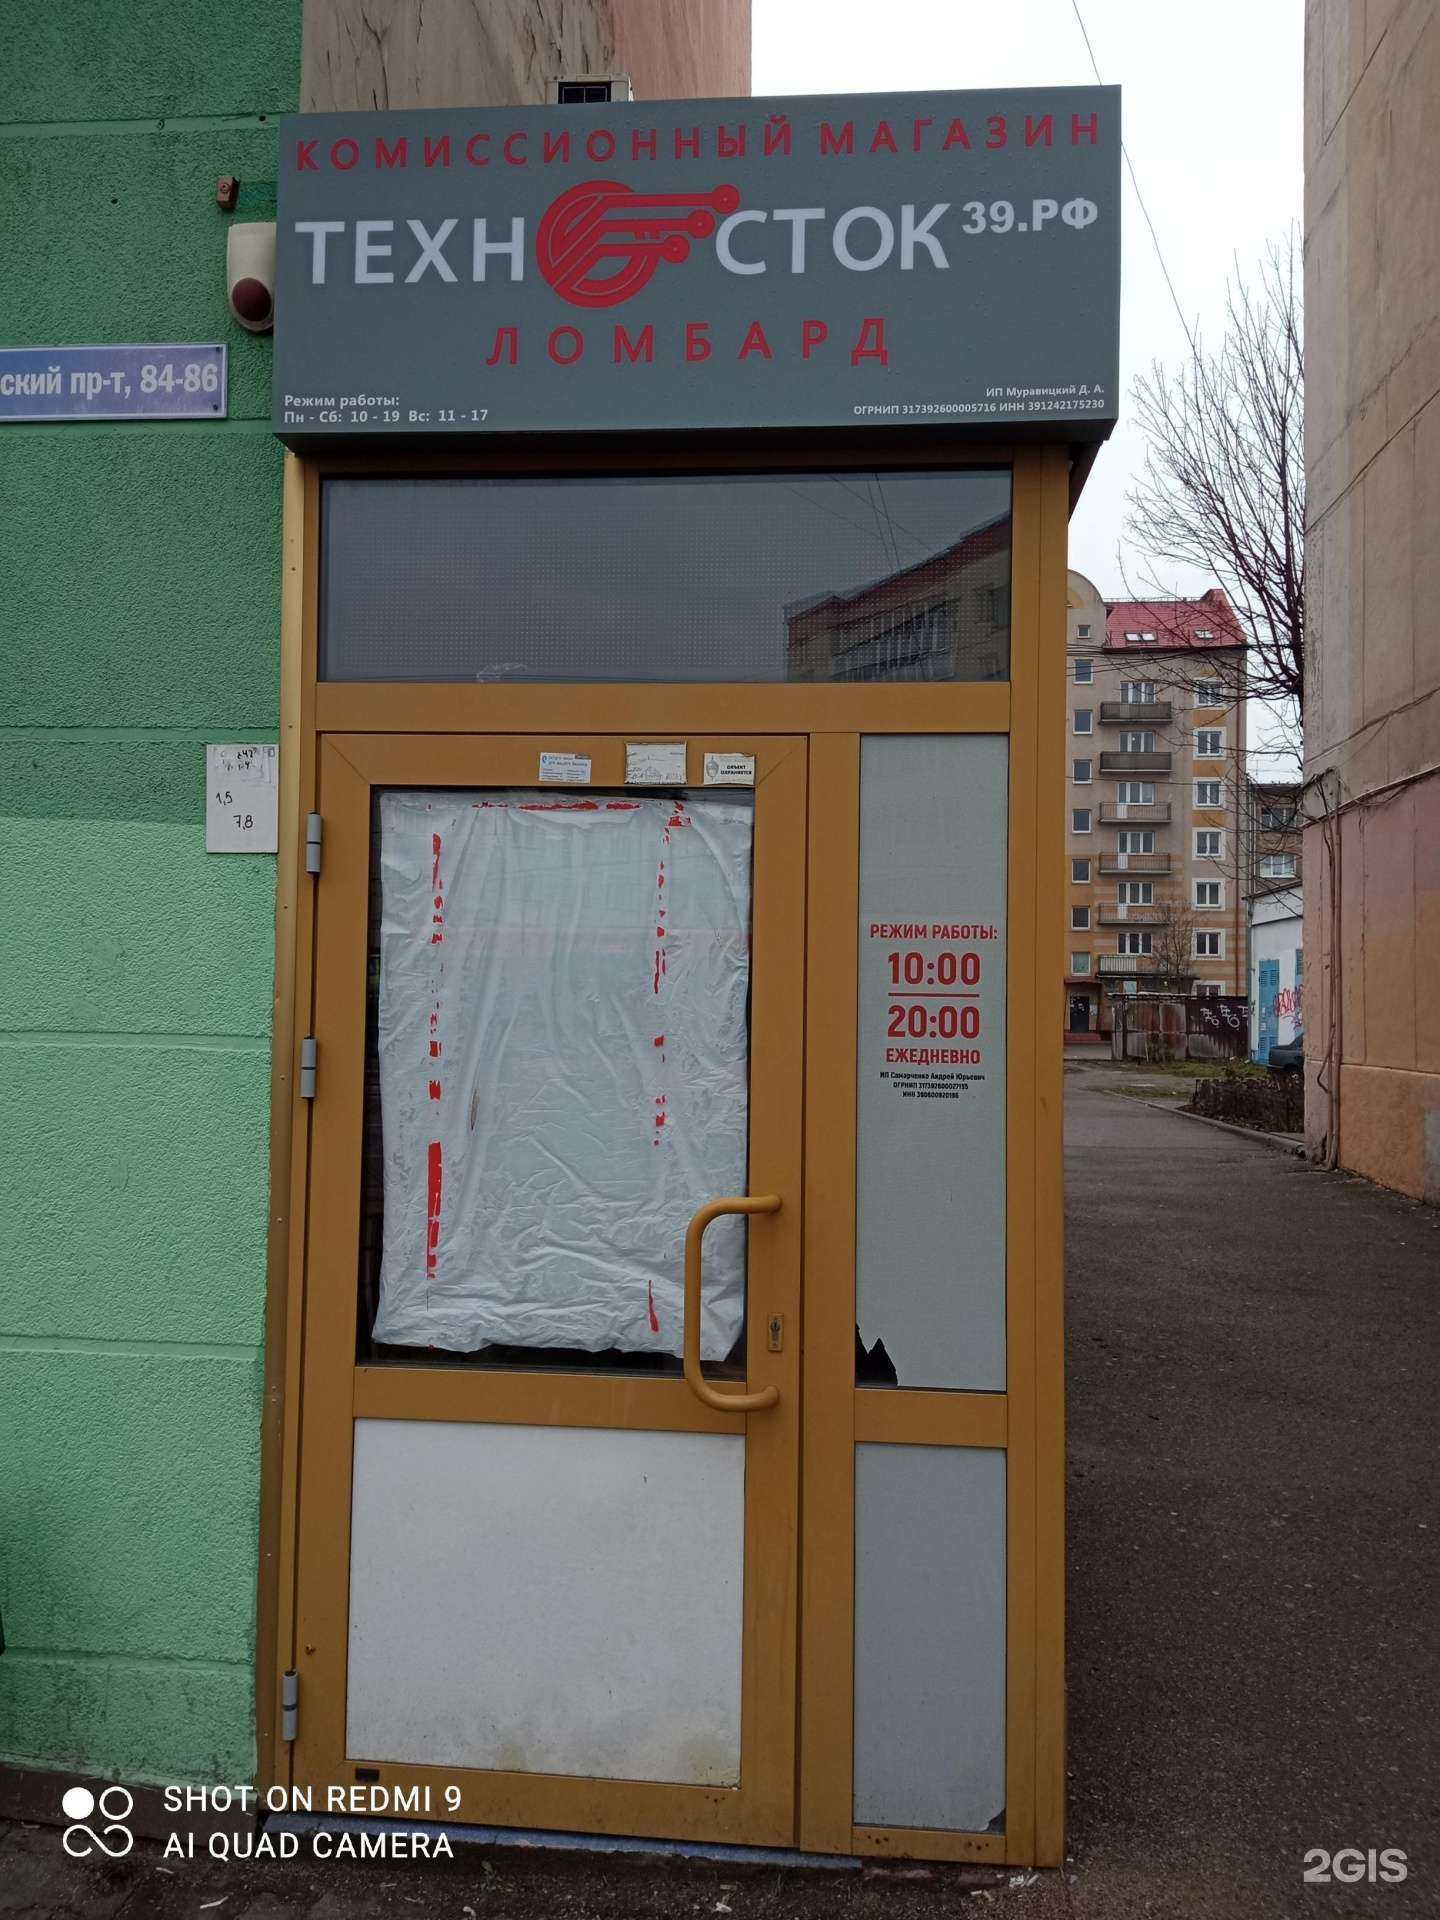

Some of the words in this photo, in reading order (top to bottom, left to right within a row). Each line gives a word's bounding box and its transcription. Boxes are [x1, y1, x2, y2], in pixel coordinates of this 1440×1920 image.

[297, 115, 792, 171] КОМИССИОННЫЙ
[820, 112, 1101, 157] МАГАЗИН
[961, 197, 1099, 235] 39.РФ
[486, 318, 890, 368] ЛОМБАРД
[70, 372, 131, 400] пр-т,
[140, 363, 218, 394] 84-86
[986, 387, 1003, 397] ИП
[1006, 384, 1076, 399] Муравицкий
[1079, 385, 1091, 395] Д.
[1093, 384, 1105, 393] А.
[284, 394, 335, 407] Режим
[339, 394, 400, 409] работы:
[853, 404, 899, 415] ОГРНИП
[902, 402, 997, 414] 317392600005716
[999, 402, 1025, 412] ИНН
[1028, 399, 1105, 411] 391242175230
[284, 411, 304, 423] Пн
[319, 411, 342, 423] Сб:
[351, 411, 368, 422] 10
[383, 410, 400, 422] 19
[408, 411, 430, 422] Вс:
[438, 410, 455, 421] 11
[471, 409, 488, 421] 17
[870, 923, 928, 939] РЕЖИМ
[932, 924, 998, 940] РАБОТЫ:
[887, 951, 981, 985] 10:00
[887, 1004, 981, 1039] 20:00
[886, 1048, 981, 1065] ЕЖЕДНЕВНО
[930, 1073, 955, 1081] Андрей
[956, 1073, 985, 1081] Юрьевич
